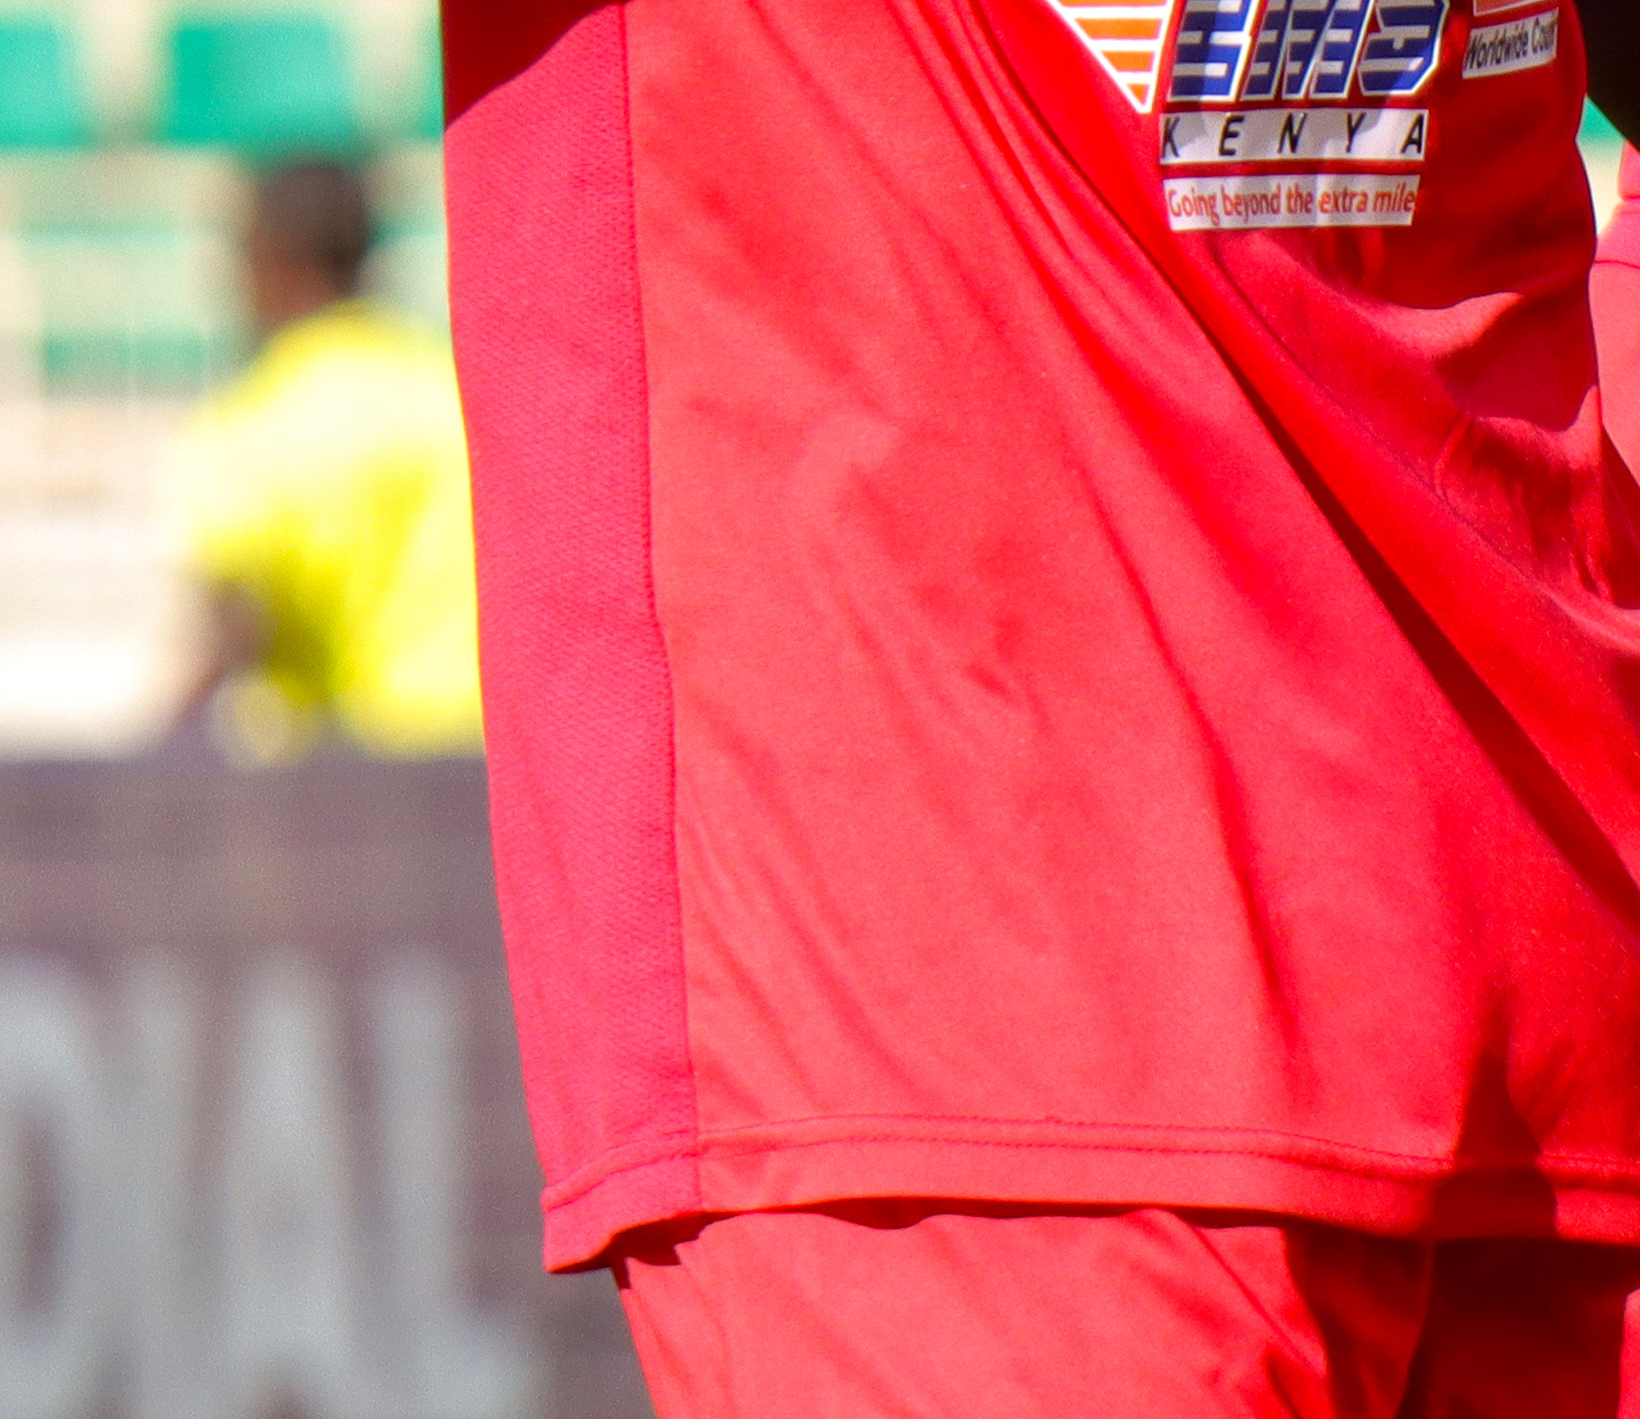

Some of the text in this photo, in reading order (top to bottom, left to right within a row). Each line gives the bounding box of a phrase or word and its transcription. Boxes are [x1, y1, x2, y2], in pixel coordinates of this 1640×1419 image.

[1464, 21, 1529, 71] Worldwide
[1160, 112, 1425, 159] KENYA
[1168, 186, 1218, 227] Going
[1220, 182, 1283, 223] beyond
[1285, 184, 1313, 214] the
[1317, 188, 1369, 215] extra
